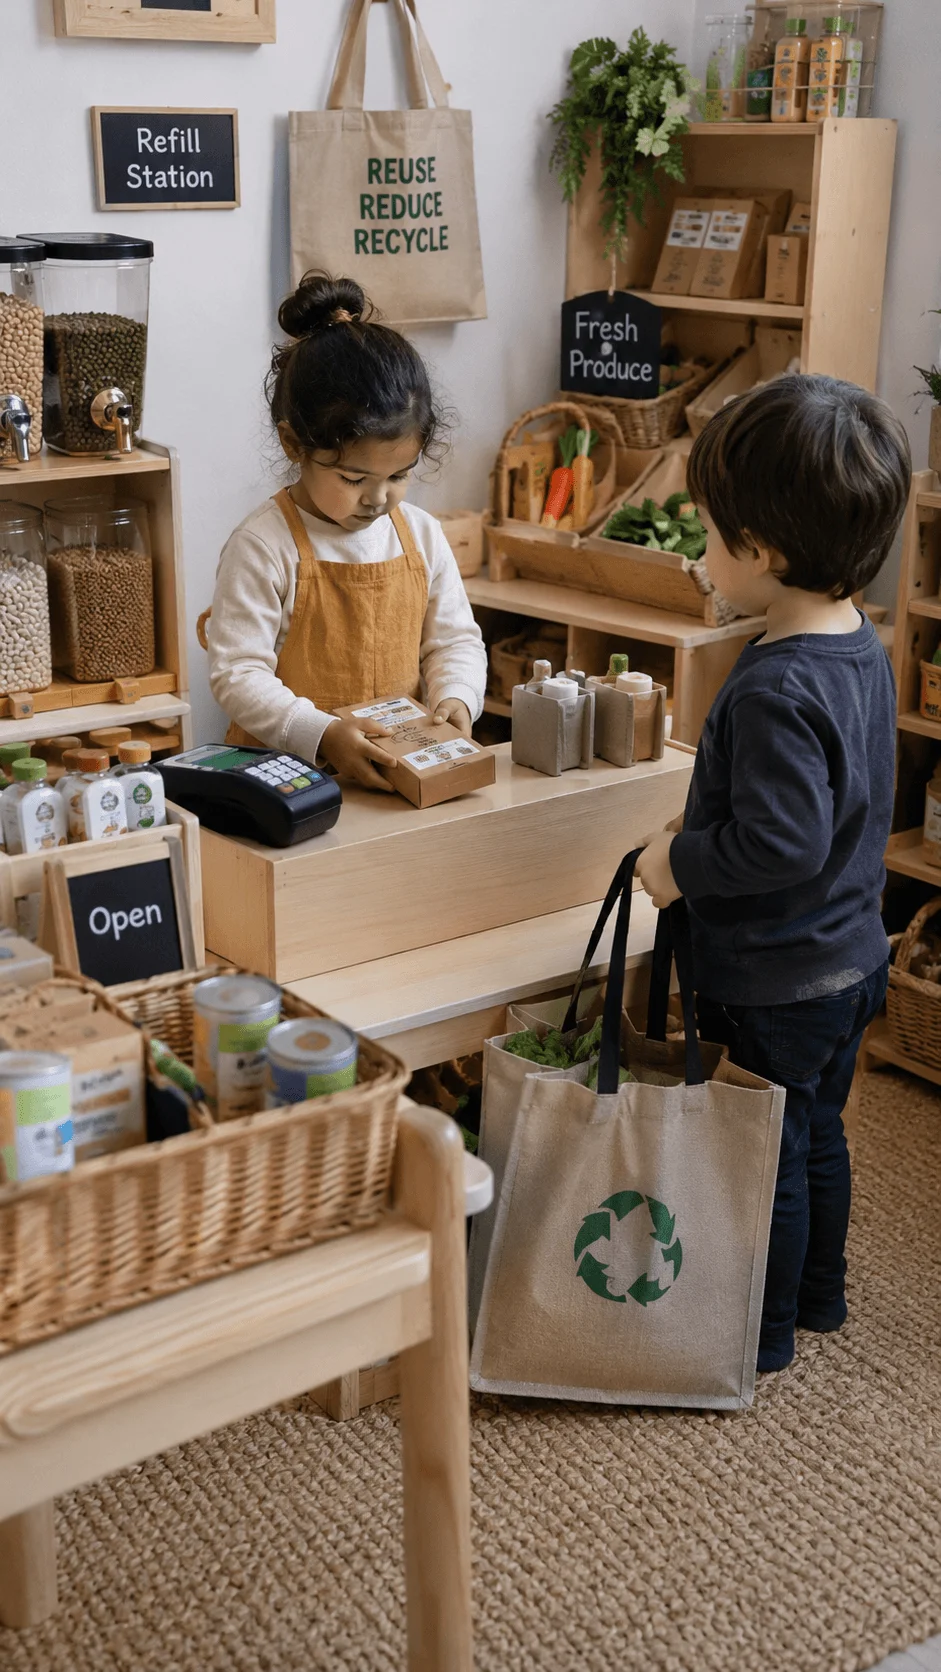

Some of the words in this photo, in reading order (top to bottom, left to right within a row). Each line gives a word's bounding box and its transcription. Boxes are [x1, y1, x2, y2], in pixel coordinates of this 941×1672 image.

[136, 127, 201, 153] Refill
[126, 163, 214, 189] Station
[367, 156, 437, 185] REUSE
[359, 191, 443, 220] REDUCE
[353, 225, 449, 255] RECYCLE
[575, 311, 638, 342] Fresh
[569, 349, 653, 382] Produce
[88, 904, 162, 941] Open
